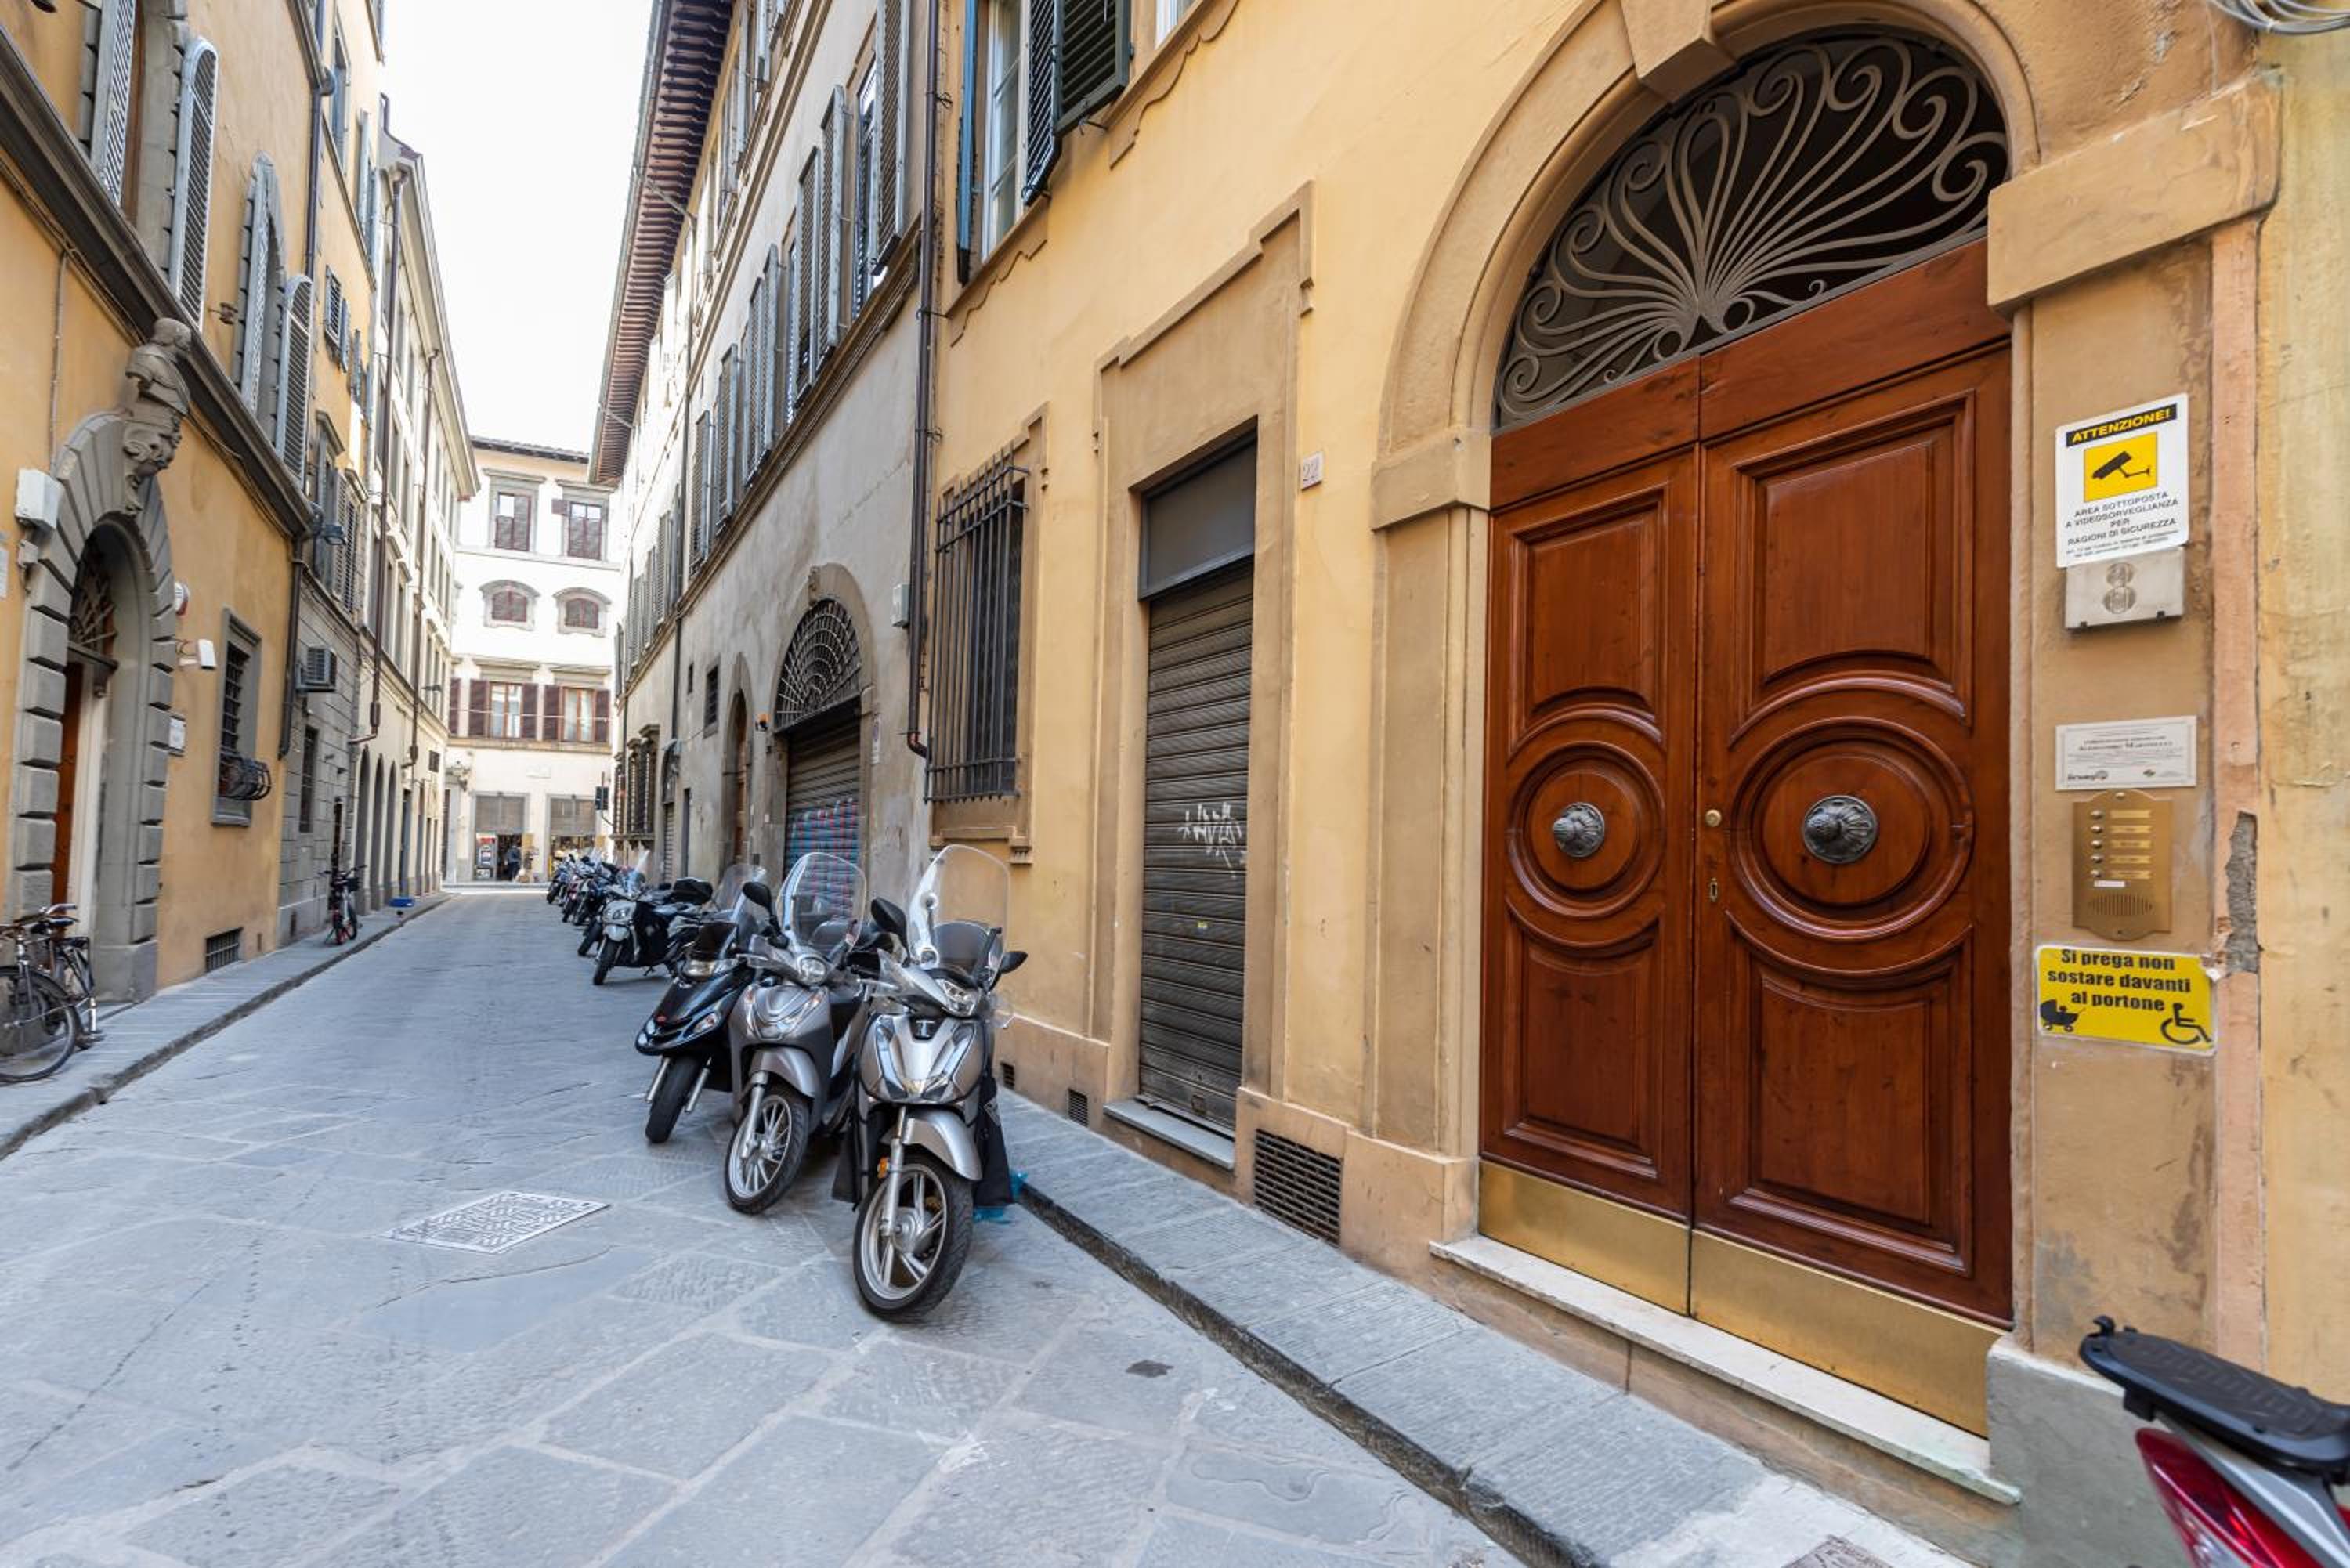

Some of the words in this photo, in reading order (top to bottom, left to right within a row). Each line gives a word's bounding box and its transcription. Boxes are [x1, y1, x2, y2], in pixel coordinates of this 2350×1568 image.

[2072, 409, 2171, 443] ATTENZIONE!
[2074, 506, 2100, 518] AREA
[2102, 491, 2168, 511] SOTTOPOSTA
[2076, 498, 2178, 526] VIDEOSORVEGLIANZA
[2068, 532, 2106, 545] RAGIONI
[2120, 518, 2176, 535] SICUREZZA
[2110, 518, 2130, 528] PER
[2061, 948, 2076, 963] Si
[2081, 953, 2134, 969] prega
[2139, 958, 2175, 970] non
[2048, 970, 2115, 987] sostare
[2120, 974, 2191, 992] davanti
[2071, 991, 2087, 1004] al
[2092, 993, 2165, 1011] portone
